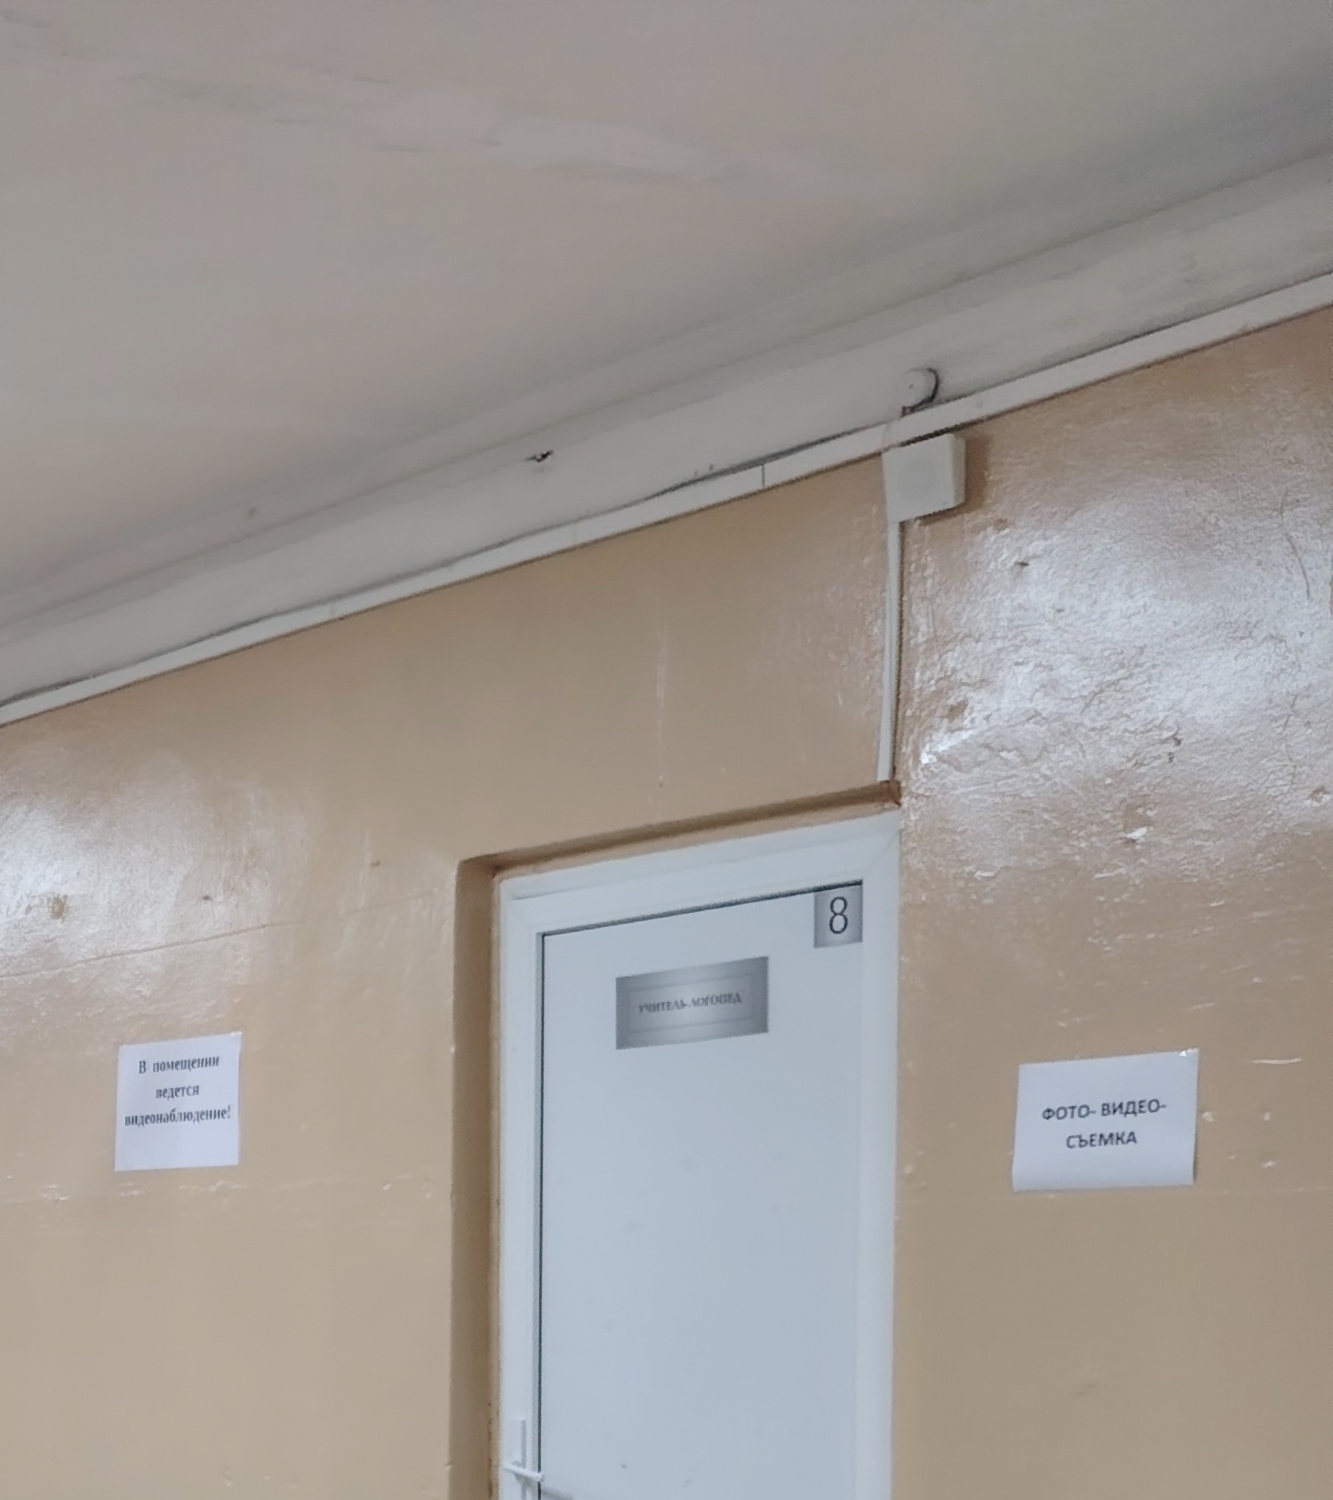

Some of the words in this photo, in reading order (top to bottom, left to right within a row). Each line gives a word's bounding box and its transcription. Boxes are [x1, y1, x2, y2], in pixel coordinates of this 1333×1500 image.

[829, 896, 848, 934] 8
[138, 1060, 147, 1074] В
[153, 1056, 220, 1072] помещении
[155, 1085, 200, 1100] ведется
[124, 1104, 231, 1127] видеонаблюдение!
[1066, 1131, 1137, 1149] СЪЕМКА
